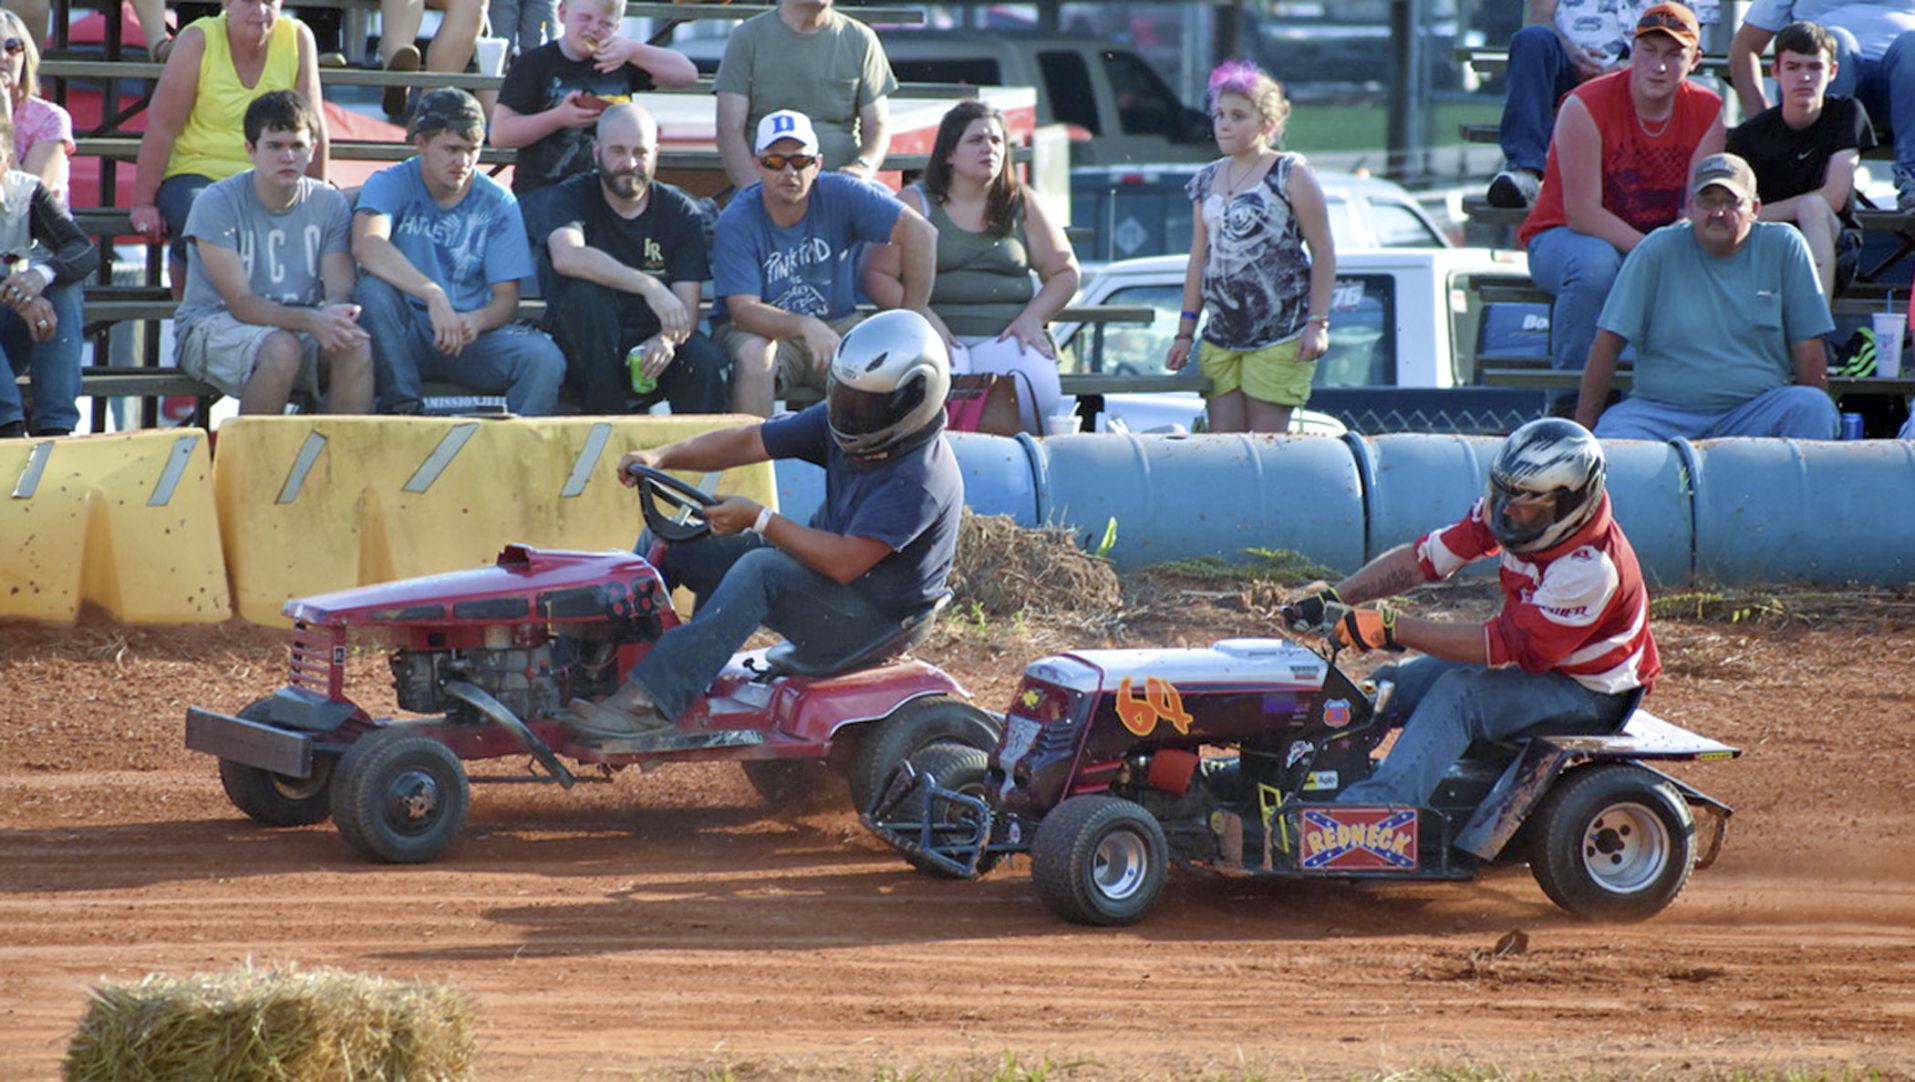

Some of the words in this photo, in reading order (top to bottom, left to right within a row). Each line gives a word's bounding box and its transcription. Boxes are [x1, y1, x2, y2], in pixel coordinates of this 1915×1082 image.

[772, 115, 795, 134] D
[763, 247, 798, 284] PINK
[1115, 676, 1194, 737] 64
[1306, 823, 1413, 856] REDNECK
